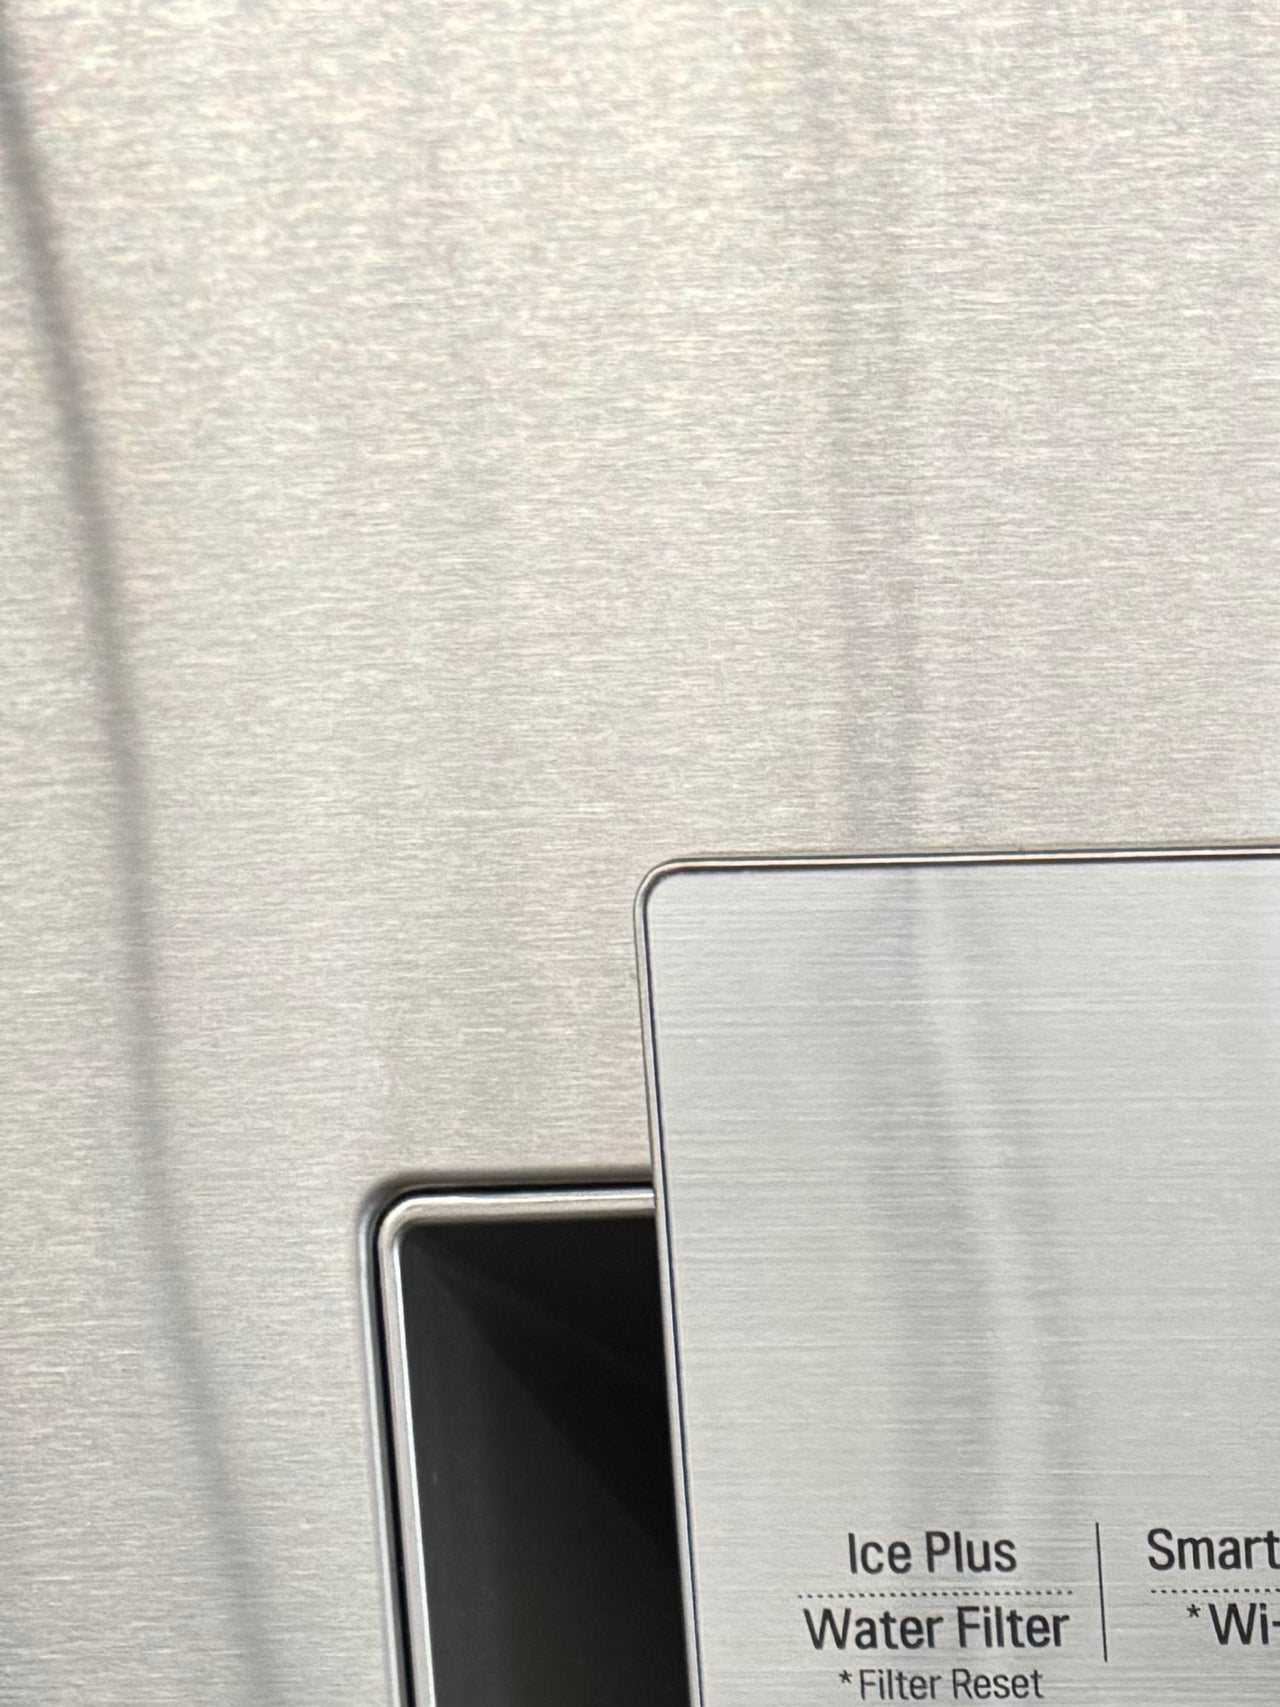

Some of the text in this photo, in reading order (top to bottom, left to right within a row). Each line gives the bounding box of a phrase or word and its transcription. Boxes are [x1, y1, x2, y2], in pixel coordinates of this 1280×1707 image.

[847, 1530, 1018, 1575] Ice Plus
[802, 1605, 1071, 1651] Water Filter
[951, 1667, 1045, 1700] Reset
